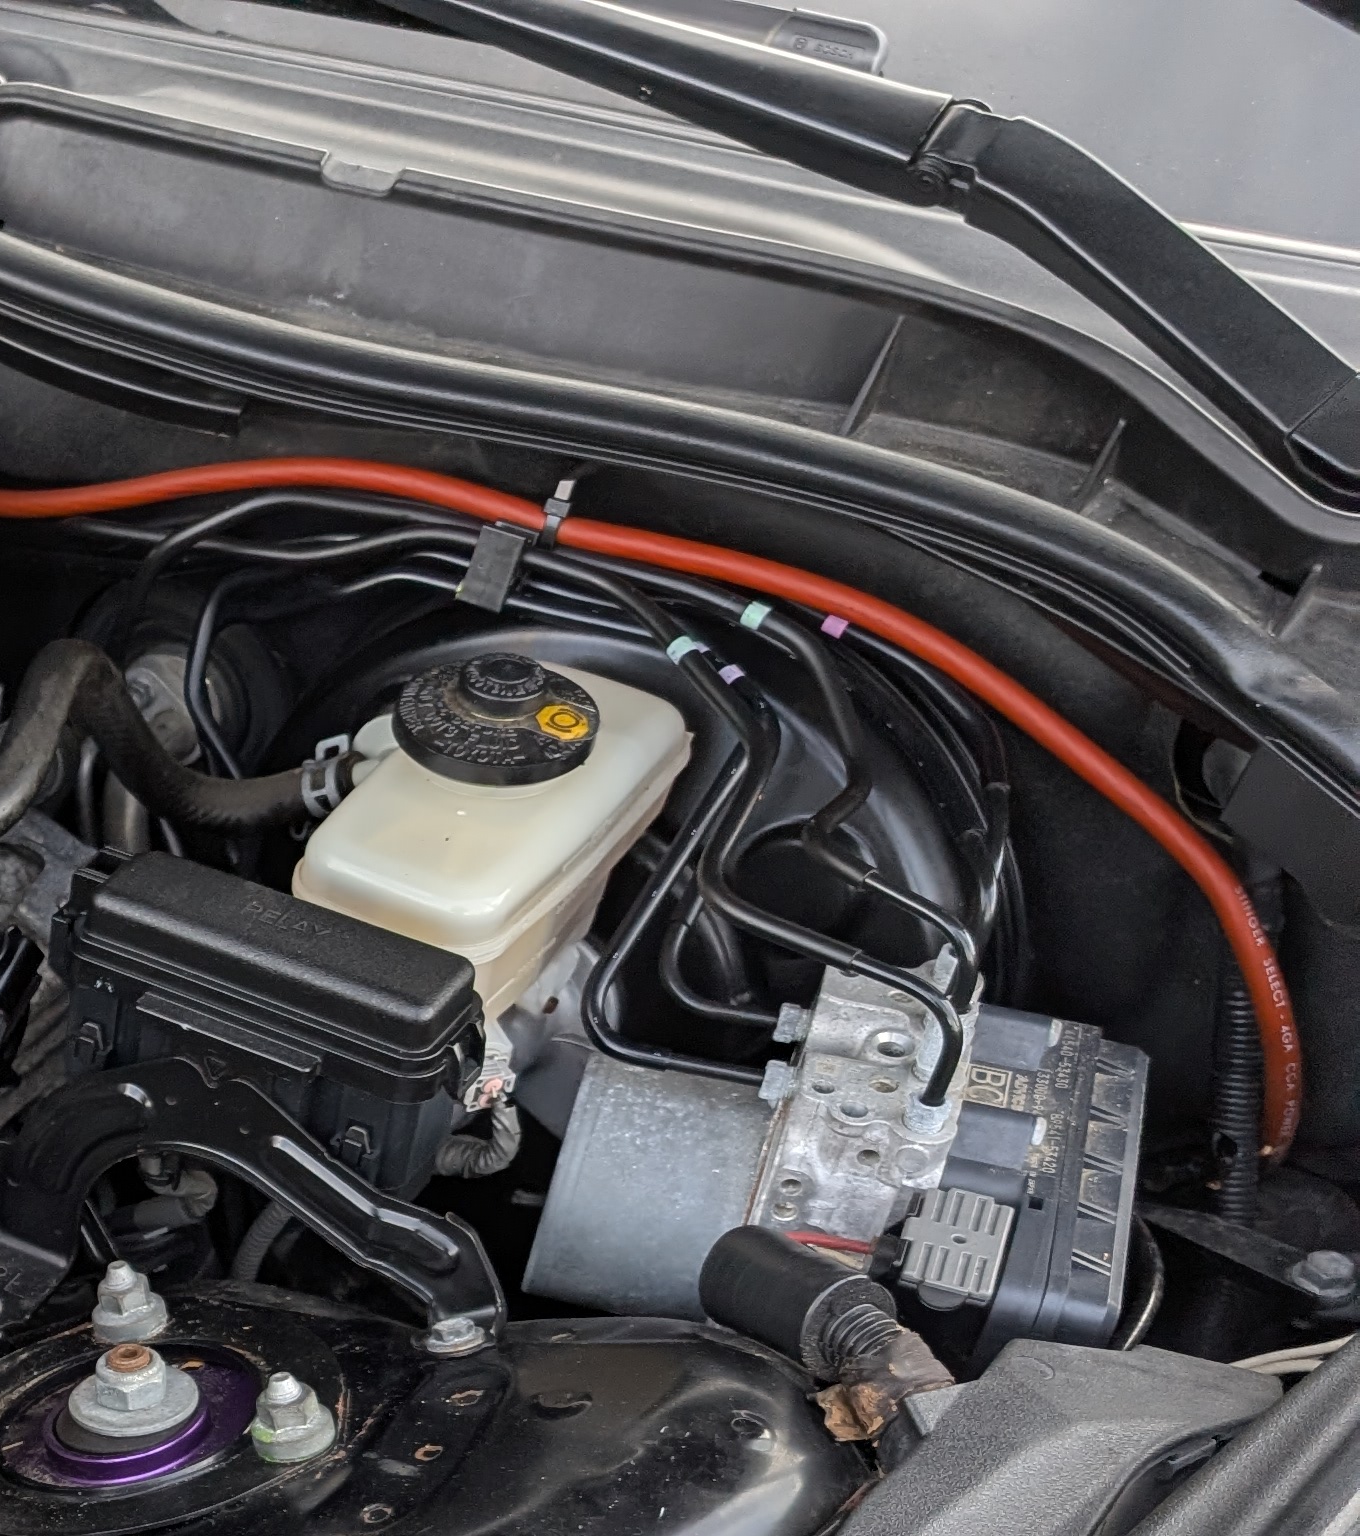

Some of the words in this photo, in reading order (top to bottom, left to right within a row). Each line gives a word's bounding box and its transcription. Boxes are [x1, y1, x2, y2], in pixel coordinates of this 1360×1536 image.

[244, 900, 334, 940] RELAY
[1263, 958, 1286, 1008] SELECT
[966, 1067, 1007, 1104] BC
